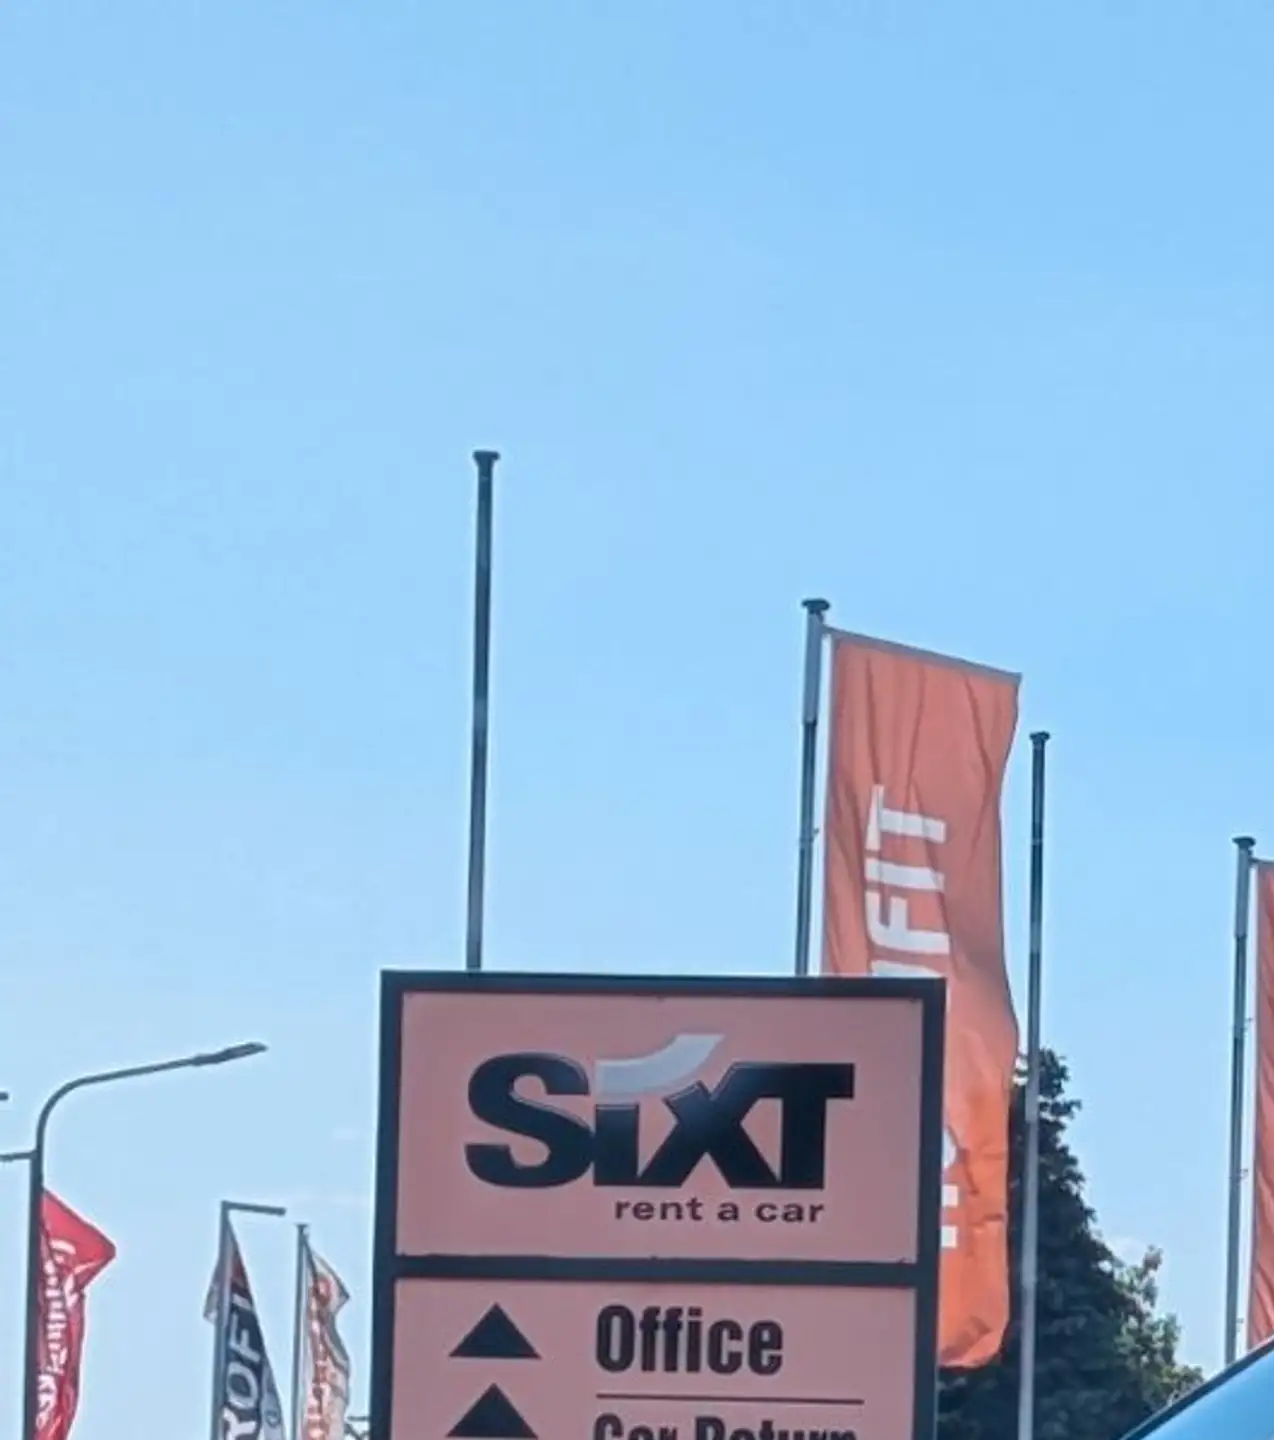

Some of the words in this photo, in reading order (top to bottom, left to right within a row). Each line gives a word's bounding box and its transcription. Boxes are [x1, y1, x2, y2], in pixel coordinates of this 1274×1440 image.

[614, 1197, 703, 1222] rent
[717, 1203, 740, 1222] a
[755, 1203, 825, 1224] car
[596, 1303, 784, 1376] Office
